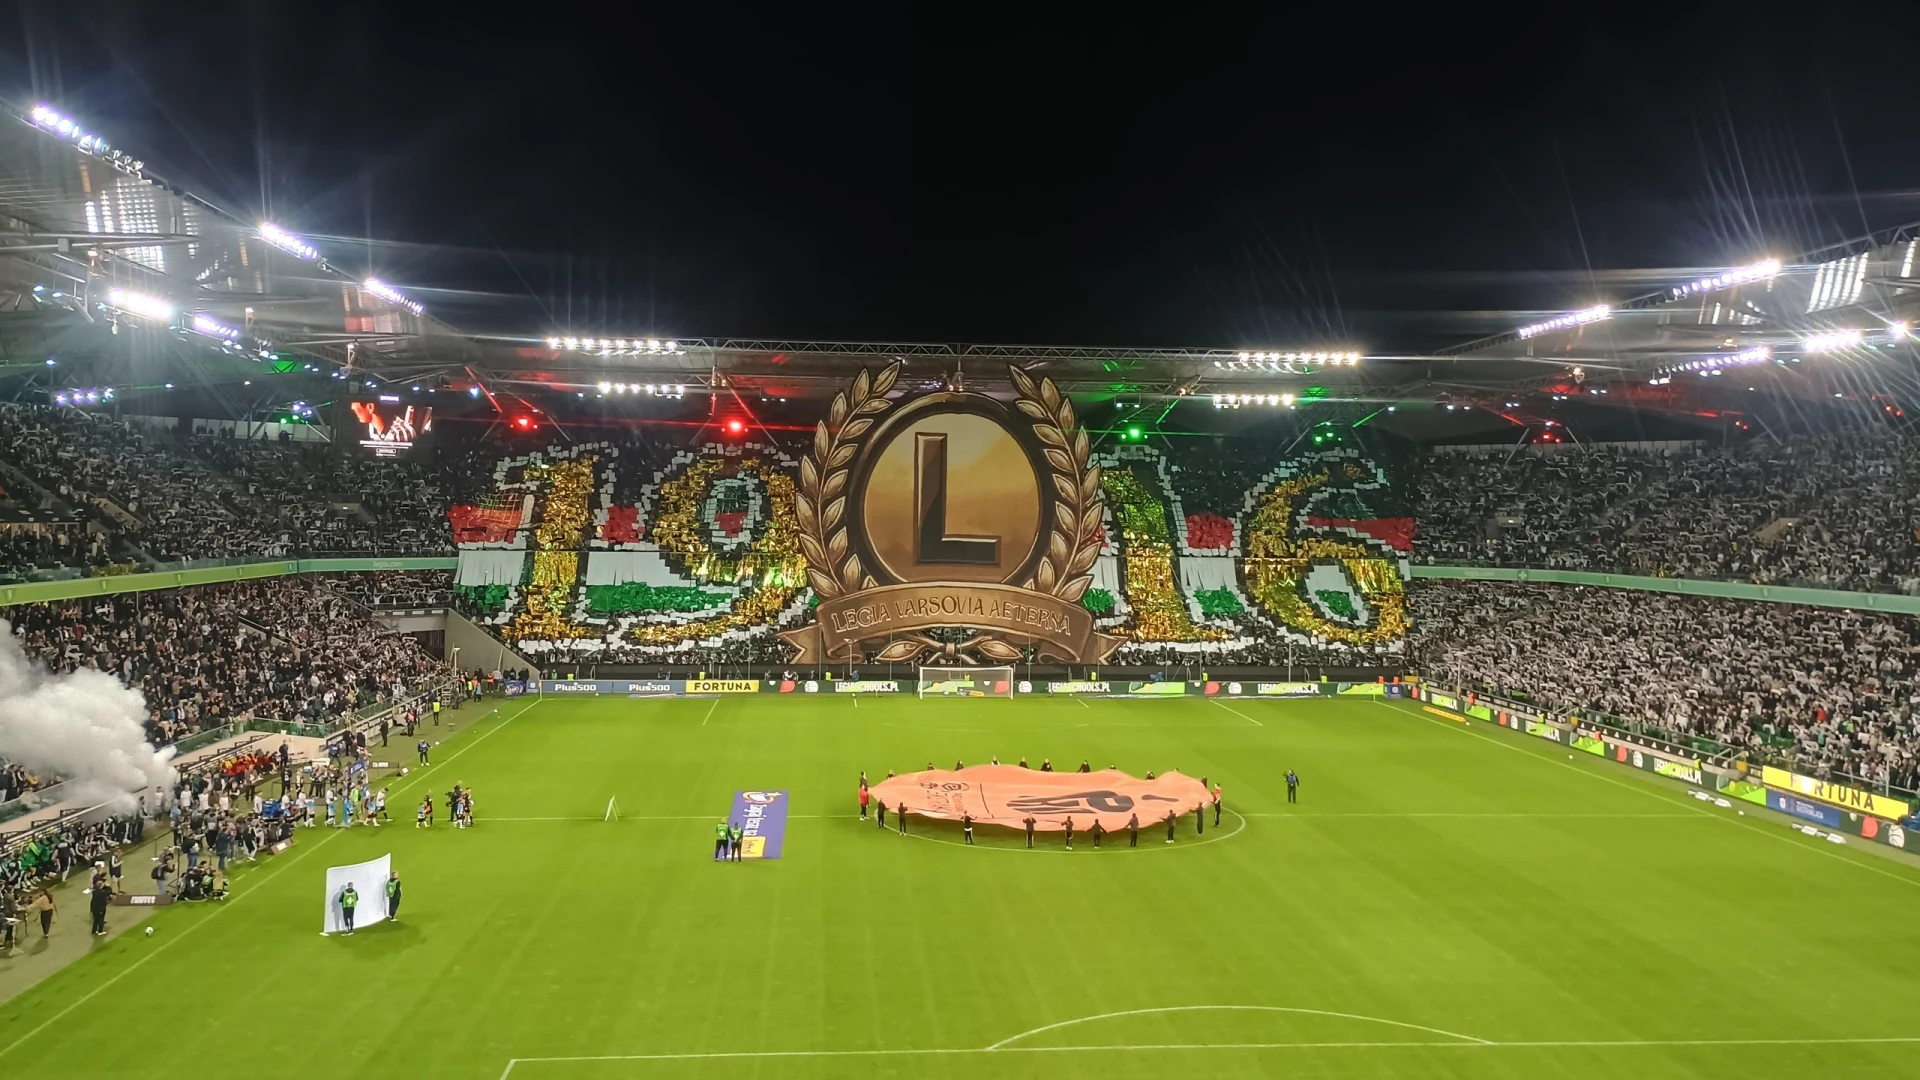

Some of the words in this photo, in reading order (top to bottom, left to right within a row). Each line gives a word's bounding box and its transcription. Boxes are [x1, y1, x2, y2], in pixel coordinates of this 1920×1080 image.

[914, 432, 1001, 567] L
[373, 560, 404, 569] legia.com
[831, 601, 891, 633] LEGIA
[895, 595, 984, 619] VARSOVIA
[988, 602, 1071, 636] AETERNA
[554, 682, 597, 691] Plus500
[628, 682, 671, 691] Plus500
[694, 682, 751, 691] FORTUNA
